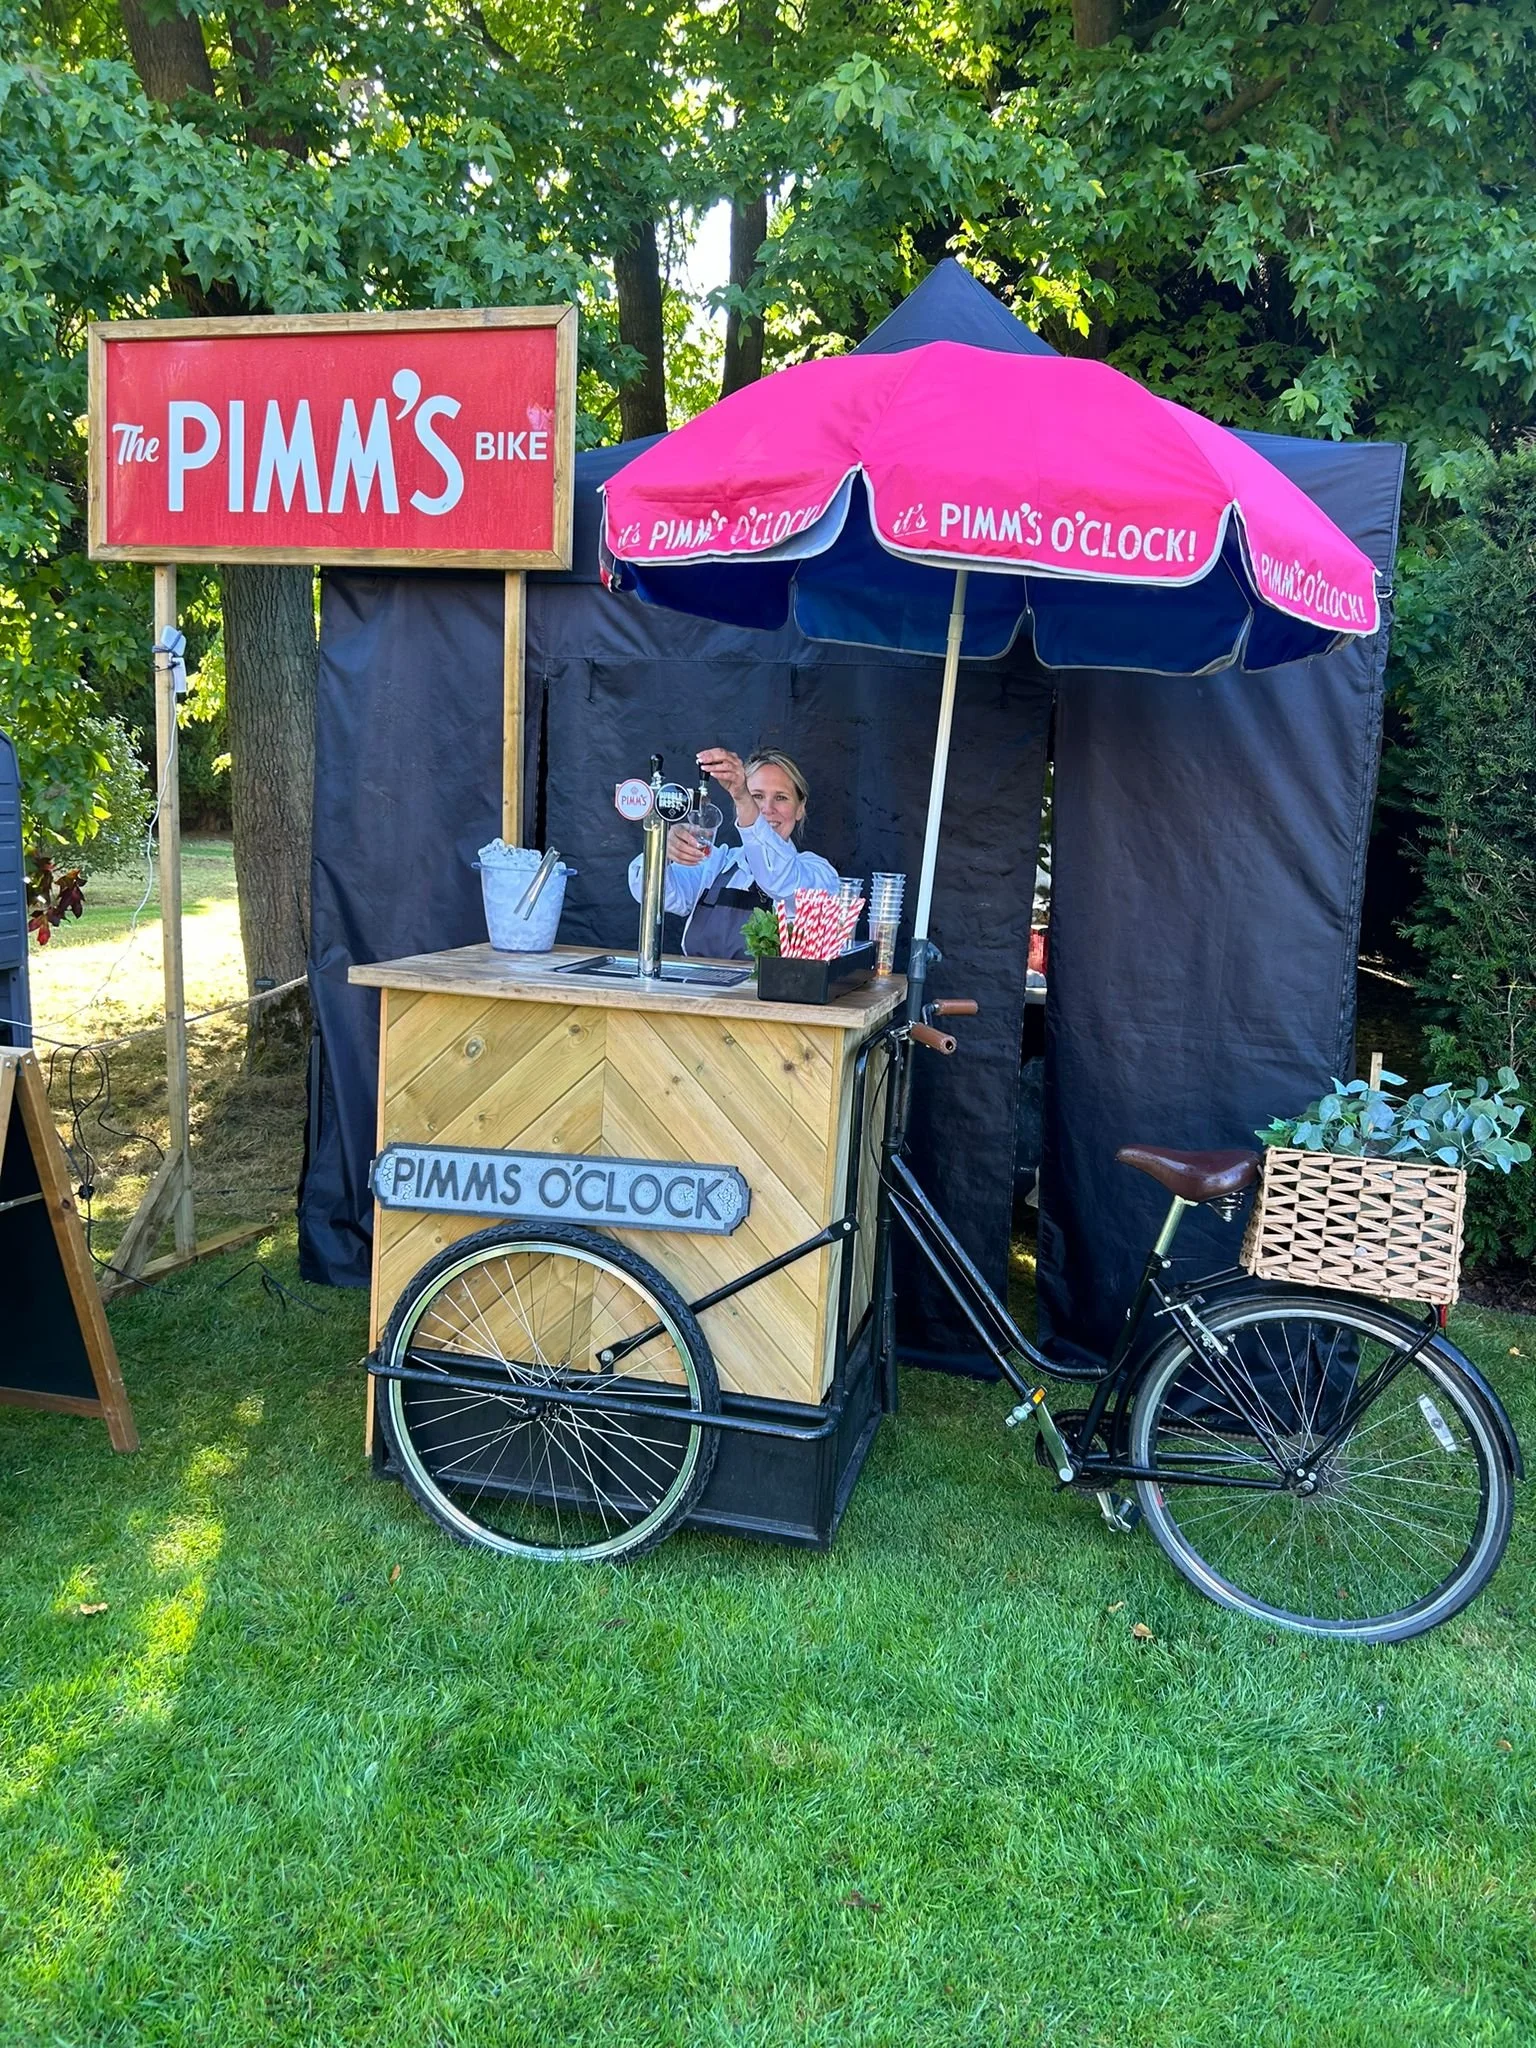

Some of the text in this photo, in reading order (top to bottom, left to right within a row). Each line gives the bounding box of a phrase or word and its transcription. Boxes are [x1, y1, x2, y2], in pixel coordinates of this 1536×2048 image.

[112, 368, 548, 516] The PIMM'S BIKE
[617, 521, 641, 552] it's
[892, 502, 1197, 563] it's PIMM'S O'CLOCK!
[1261, 552, 1305, 602] PIMM'S
[1303, 569, 1368, 624] O'CLOCK!
[621, 793, 648, 807] PIMM'S
[391, 1156, 724, 1222] PIMMS O'CLOCK
